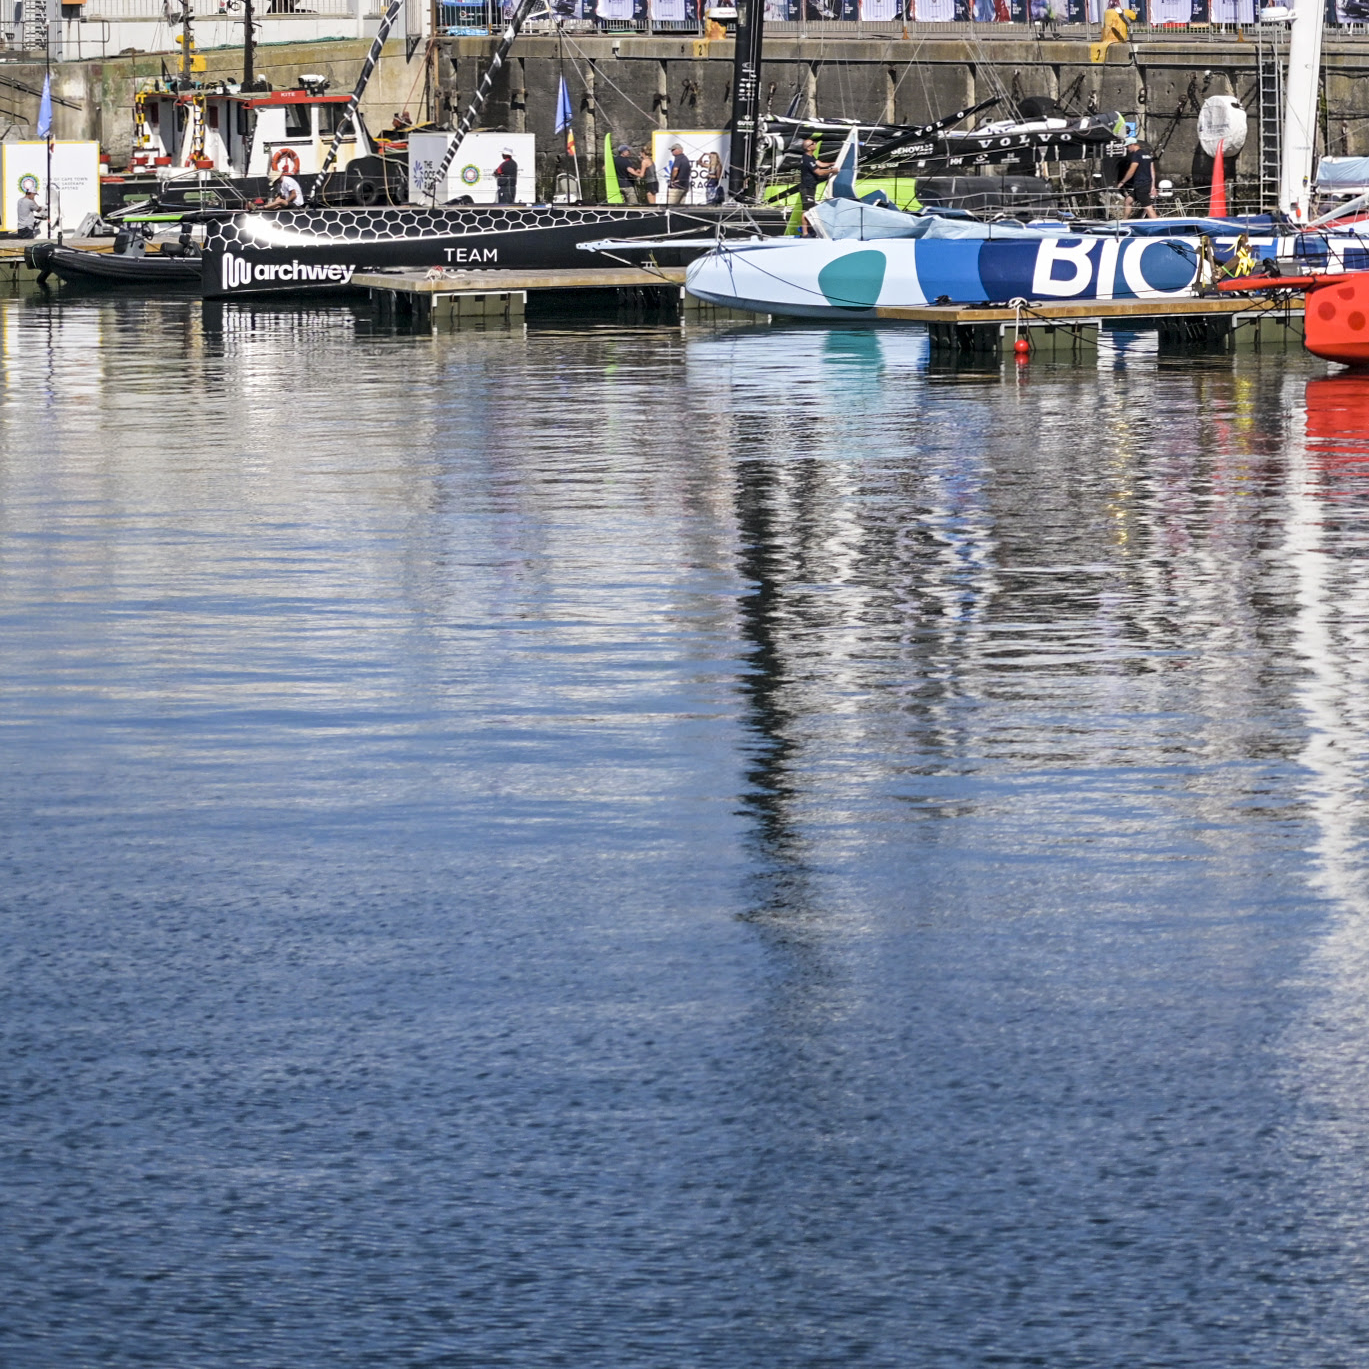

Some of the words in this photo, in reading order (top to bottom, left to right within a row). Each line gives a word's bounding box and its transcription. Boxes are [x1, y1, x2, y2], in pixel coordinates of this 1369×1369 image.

[978, 133, 1071, 149] VOLVO
[424, 160, 433, 169] THE
[444, 248, 498, 262] TEAM
[254, 259, 356, 285] archwey
